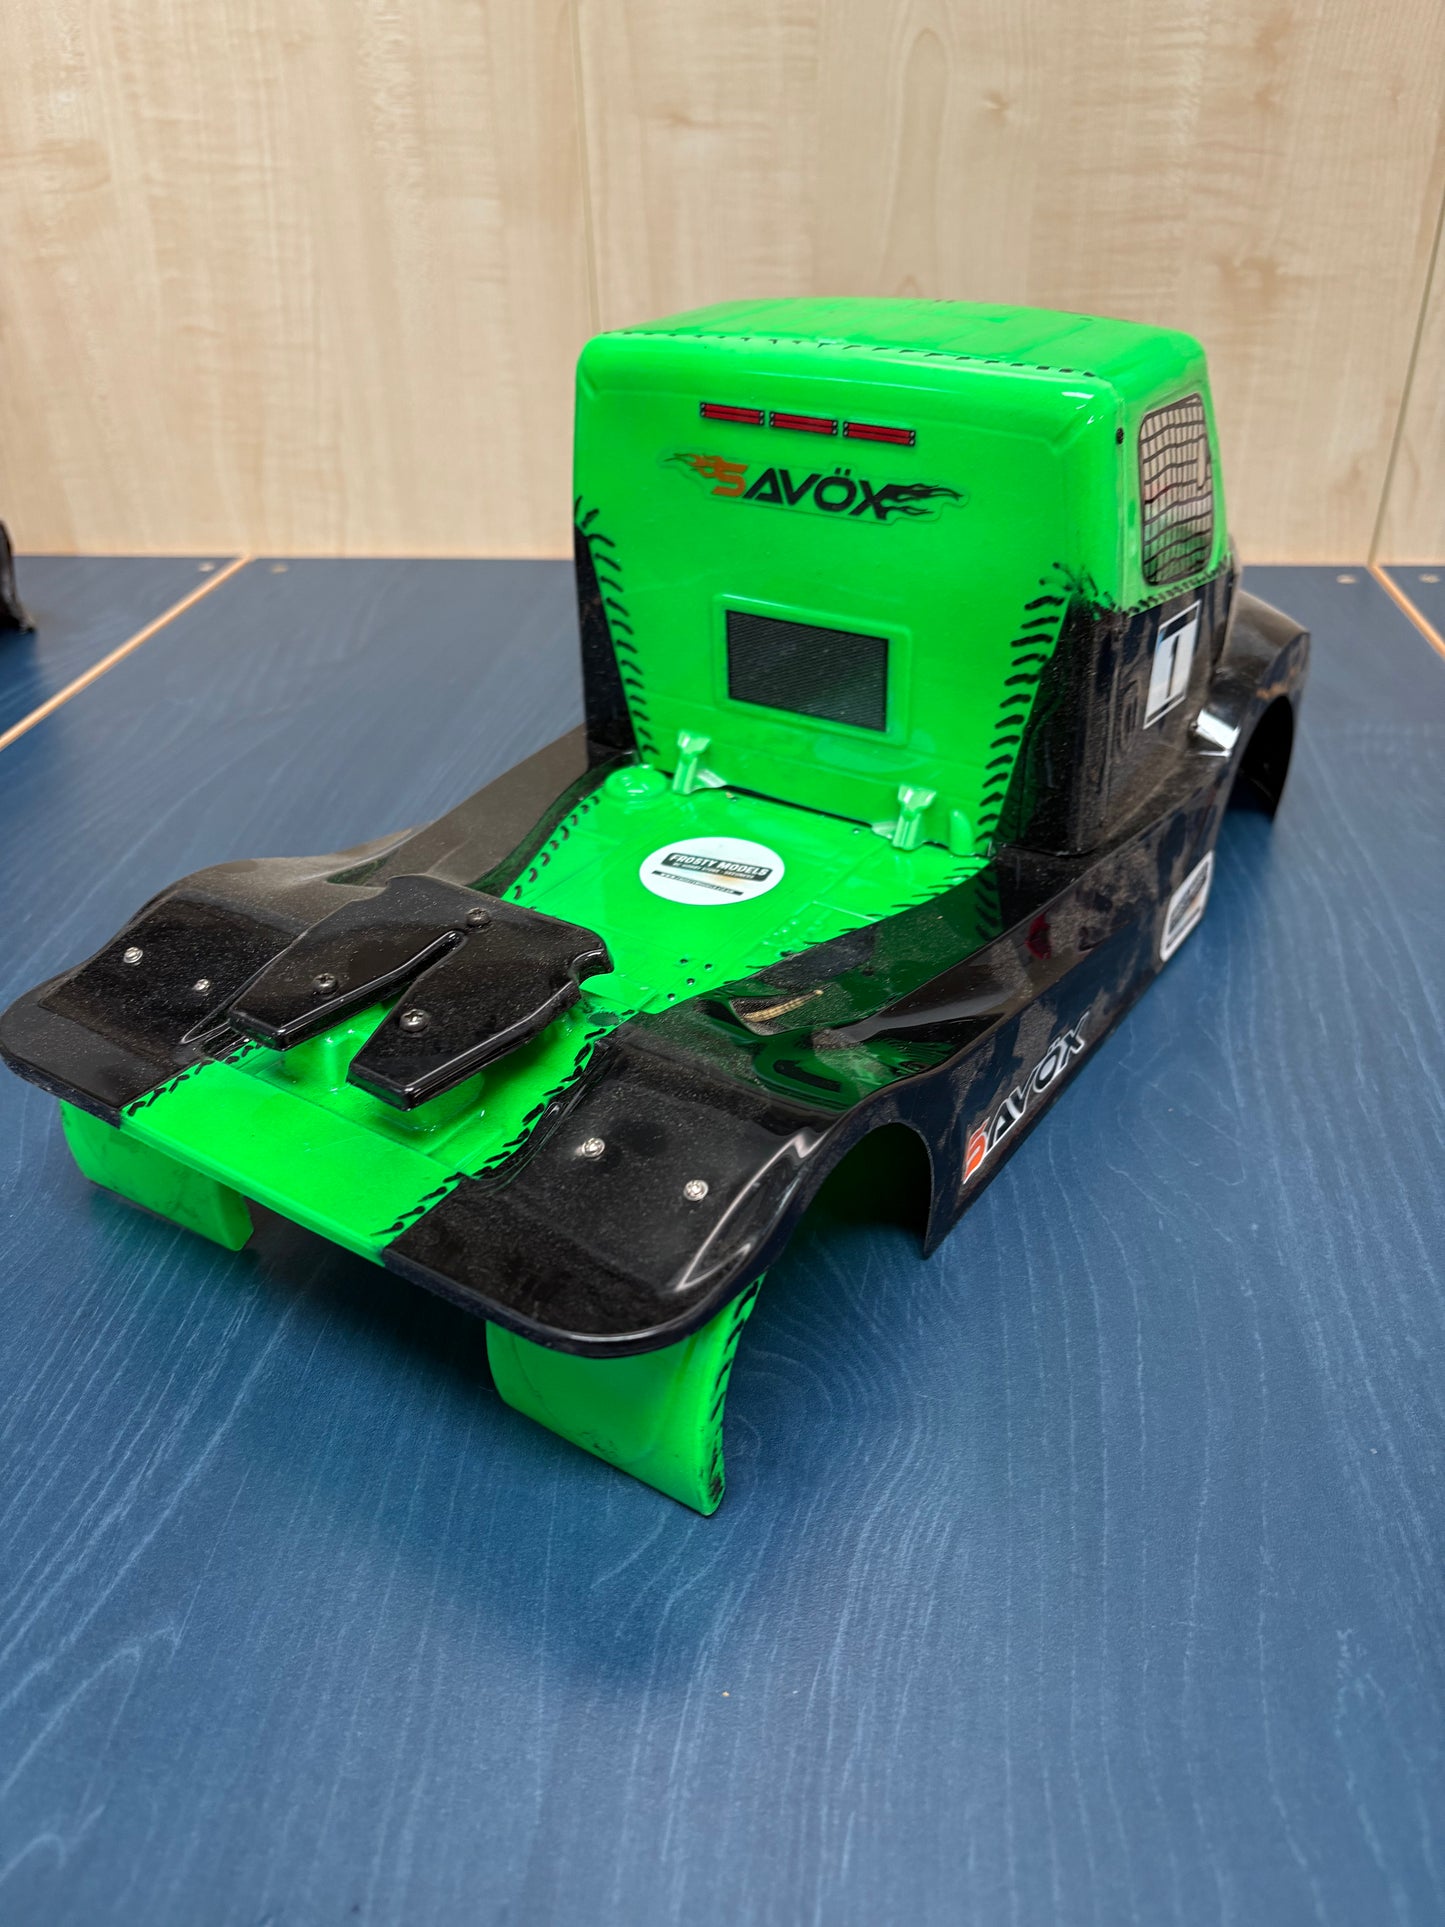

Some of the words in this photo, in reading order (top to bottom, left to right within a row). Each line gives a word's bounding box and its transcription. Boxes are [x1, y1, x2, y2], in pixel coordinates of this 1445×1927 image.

[1166, 633, 1180, 700] 1
[669, 854, 718, 867] FROSTY
[716, 861, 769, 876] MODELS
